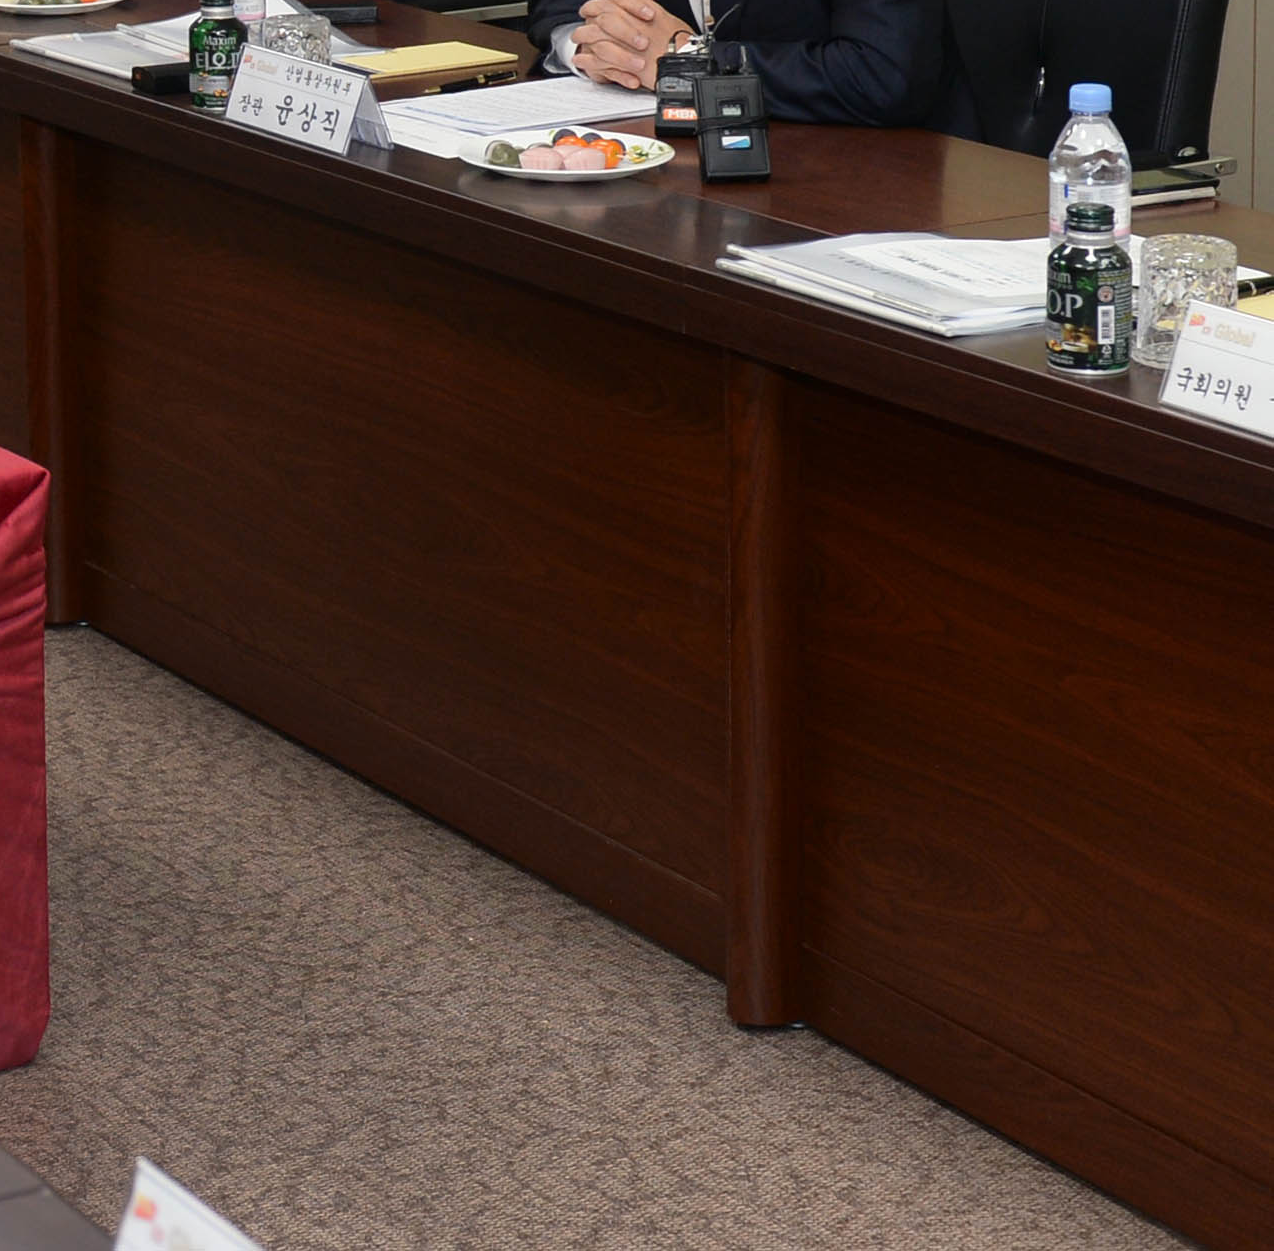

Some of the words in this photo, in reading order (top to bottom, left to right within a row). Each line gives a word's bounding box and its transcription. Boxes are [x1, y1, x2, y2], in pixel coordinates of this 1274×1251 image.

[203, 35, 237, 45] Maxim
[285, 62, 353, 96] 산업통상자원부
[238, 94, 265, 117] 장관
[275, 94, 341, 141] 윤상직
[1176, 365, 1253, 411] 국회의원
